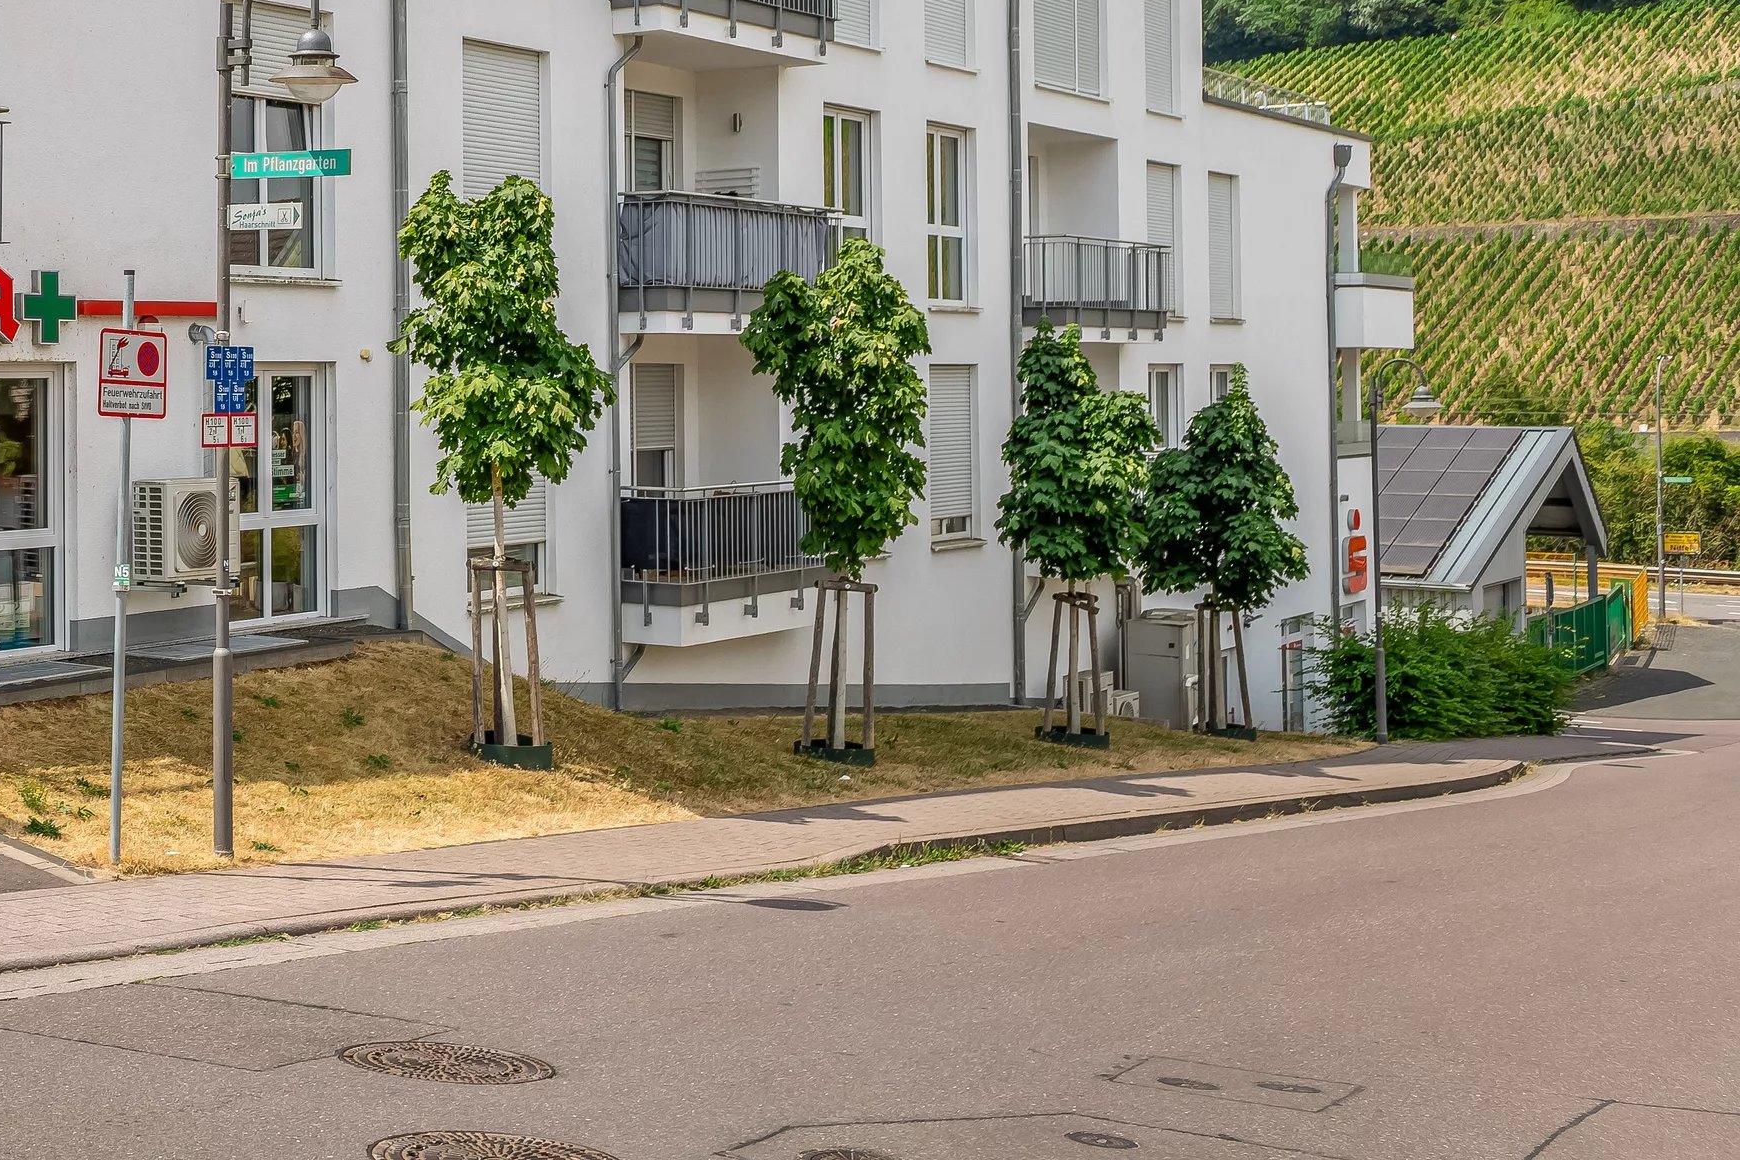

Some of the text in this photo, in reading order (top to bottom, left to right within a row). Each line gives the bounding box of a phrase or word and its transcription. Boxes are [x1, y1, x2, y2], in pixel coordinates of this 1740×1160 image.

[244, 156, 336, 174] Im Pflanzgarten
[232, 207, 266, 224] Sonja's
[239, 220, 276, 229] Haarschnitt
[103, 387, 162, 399] Feuerwehrzufahrt
[129, 402, 140, 410] nach
[205, 417, 222, 426] H100
[115, 566, 129, 578] N5
